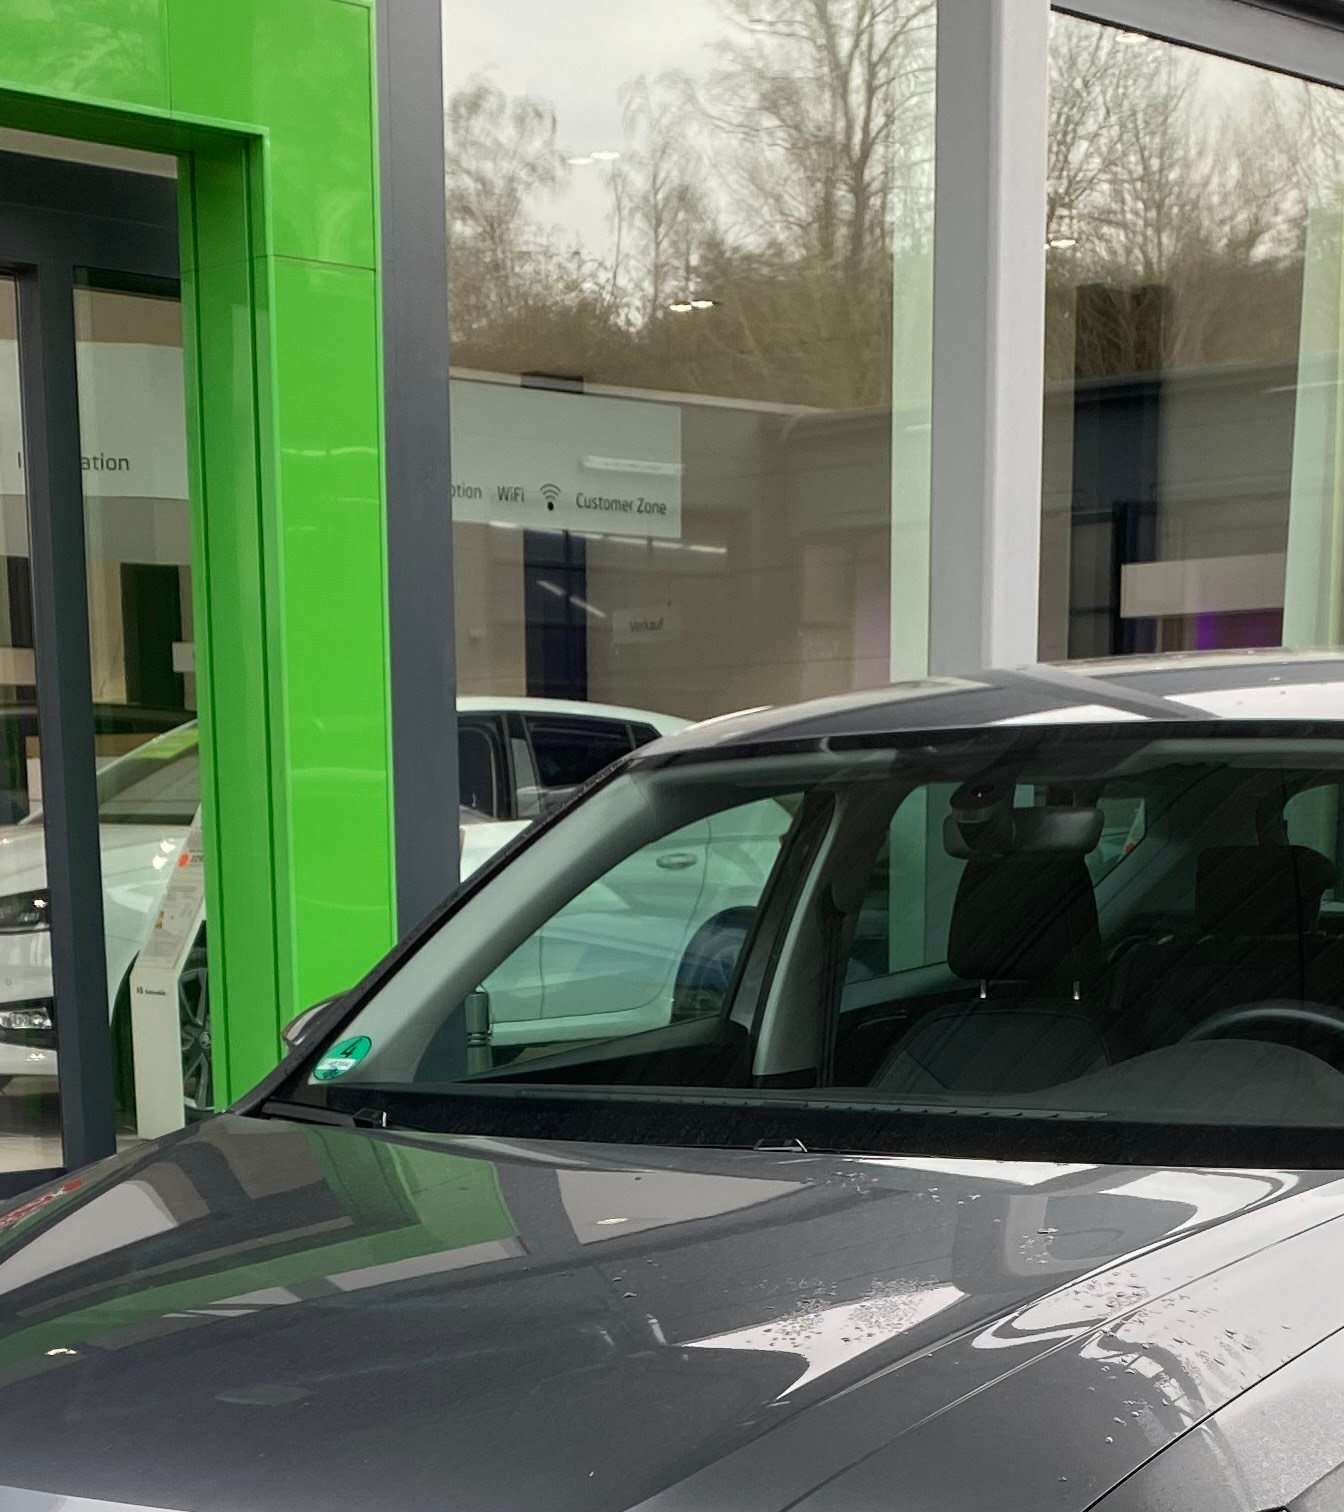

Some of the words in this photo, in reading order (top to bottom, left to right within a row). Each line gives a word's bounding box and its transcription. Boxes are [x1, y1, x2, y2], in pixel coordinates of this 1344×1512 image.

[496, 484, 525, 504] WiFi
[575, 492, 634, 513] Customer
[636, 497, 667, 516] Zone
